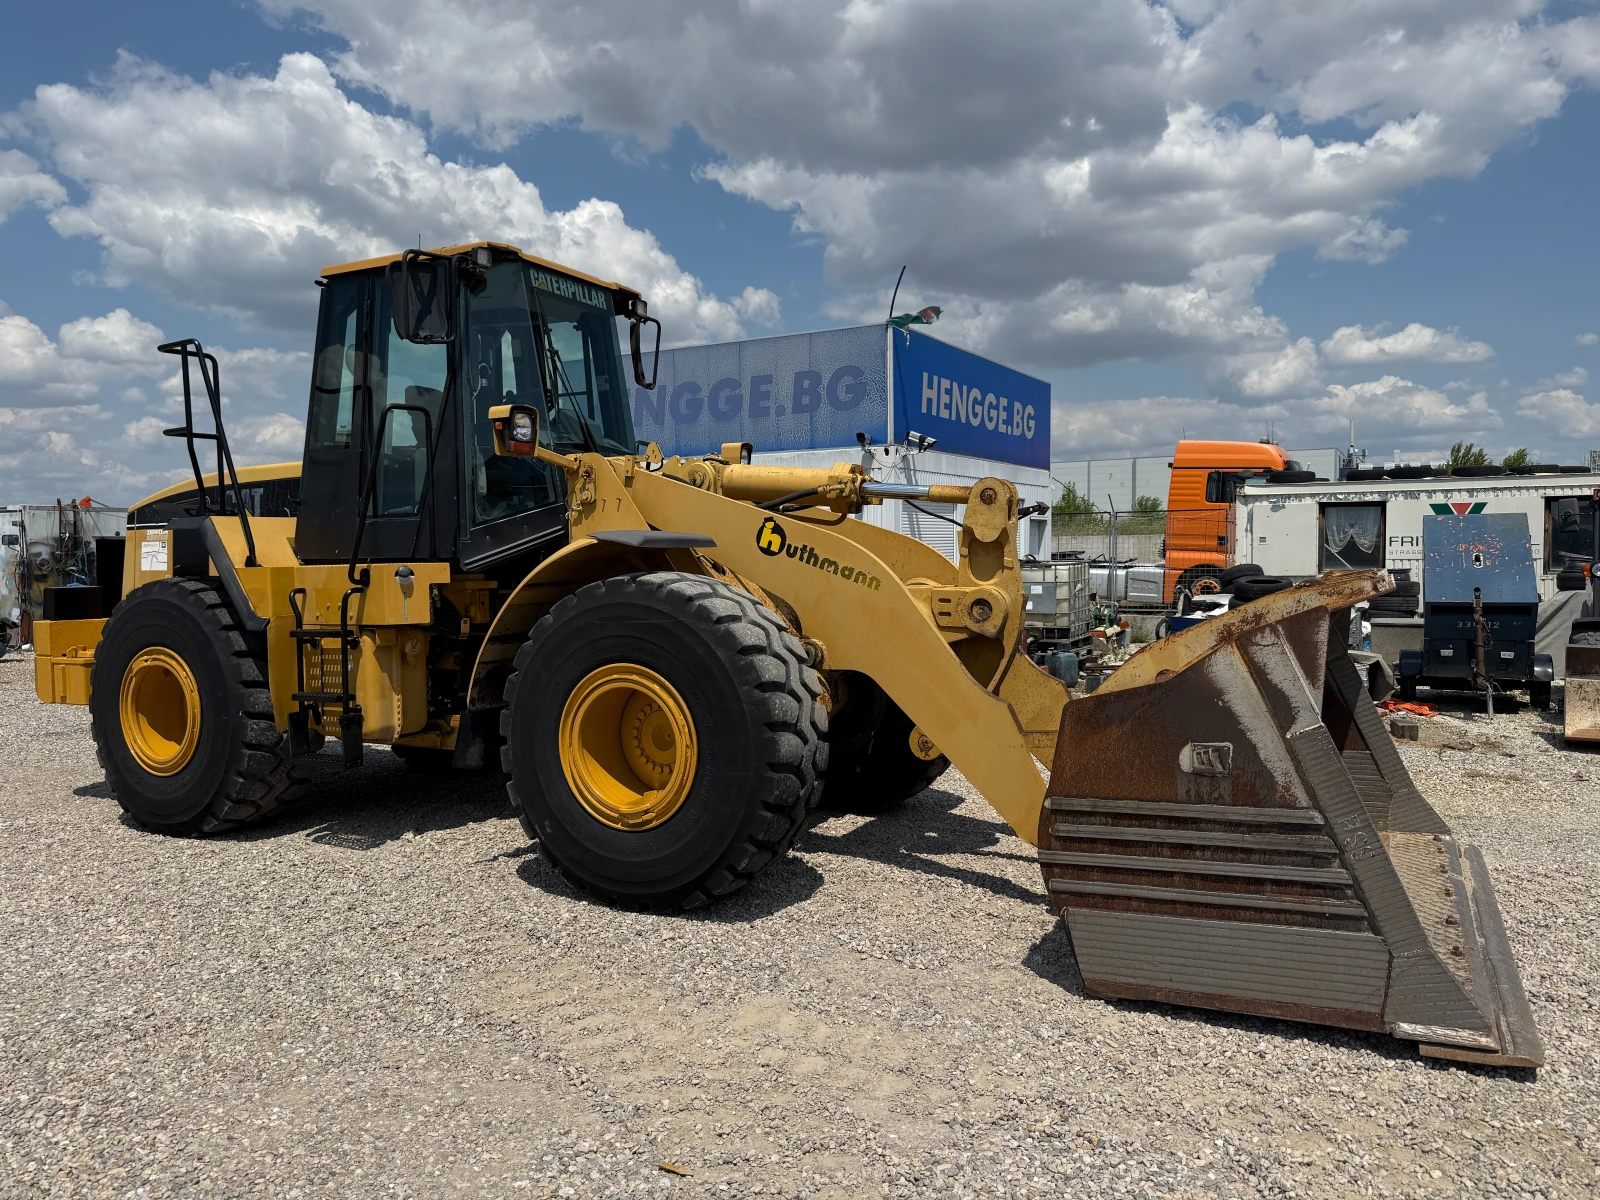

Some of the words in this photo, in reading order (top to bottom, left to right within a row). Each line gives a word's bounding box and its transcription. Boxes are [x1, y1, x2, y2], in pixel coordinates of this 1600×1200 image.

[530, 268, 607, 310] CATERPILLAR
[628, 365, 866, 428] NGGE.BG
[921, 372, 1036, 439] HENGGE.BG
[756, 517, 882, 592] huthmann
[1389, 536, 1423, 547] FRI
